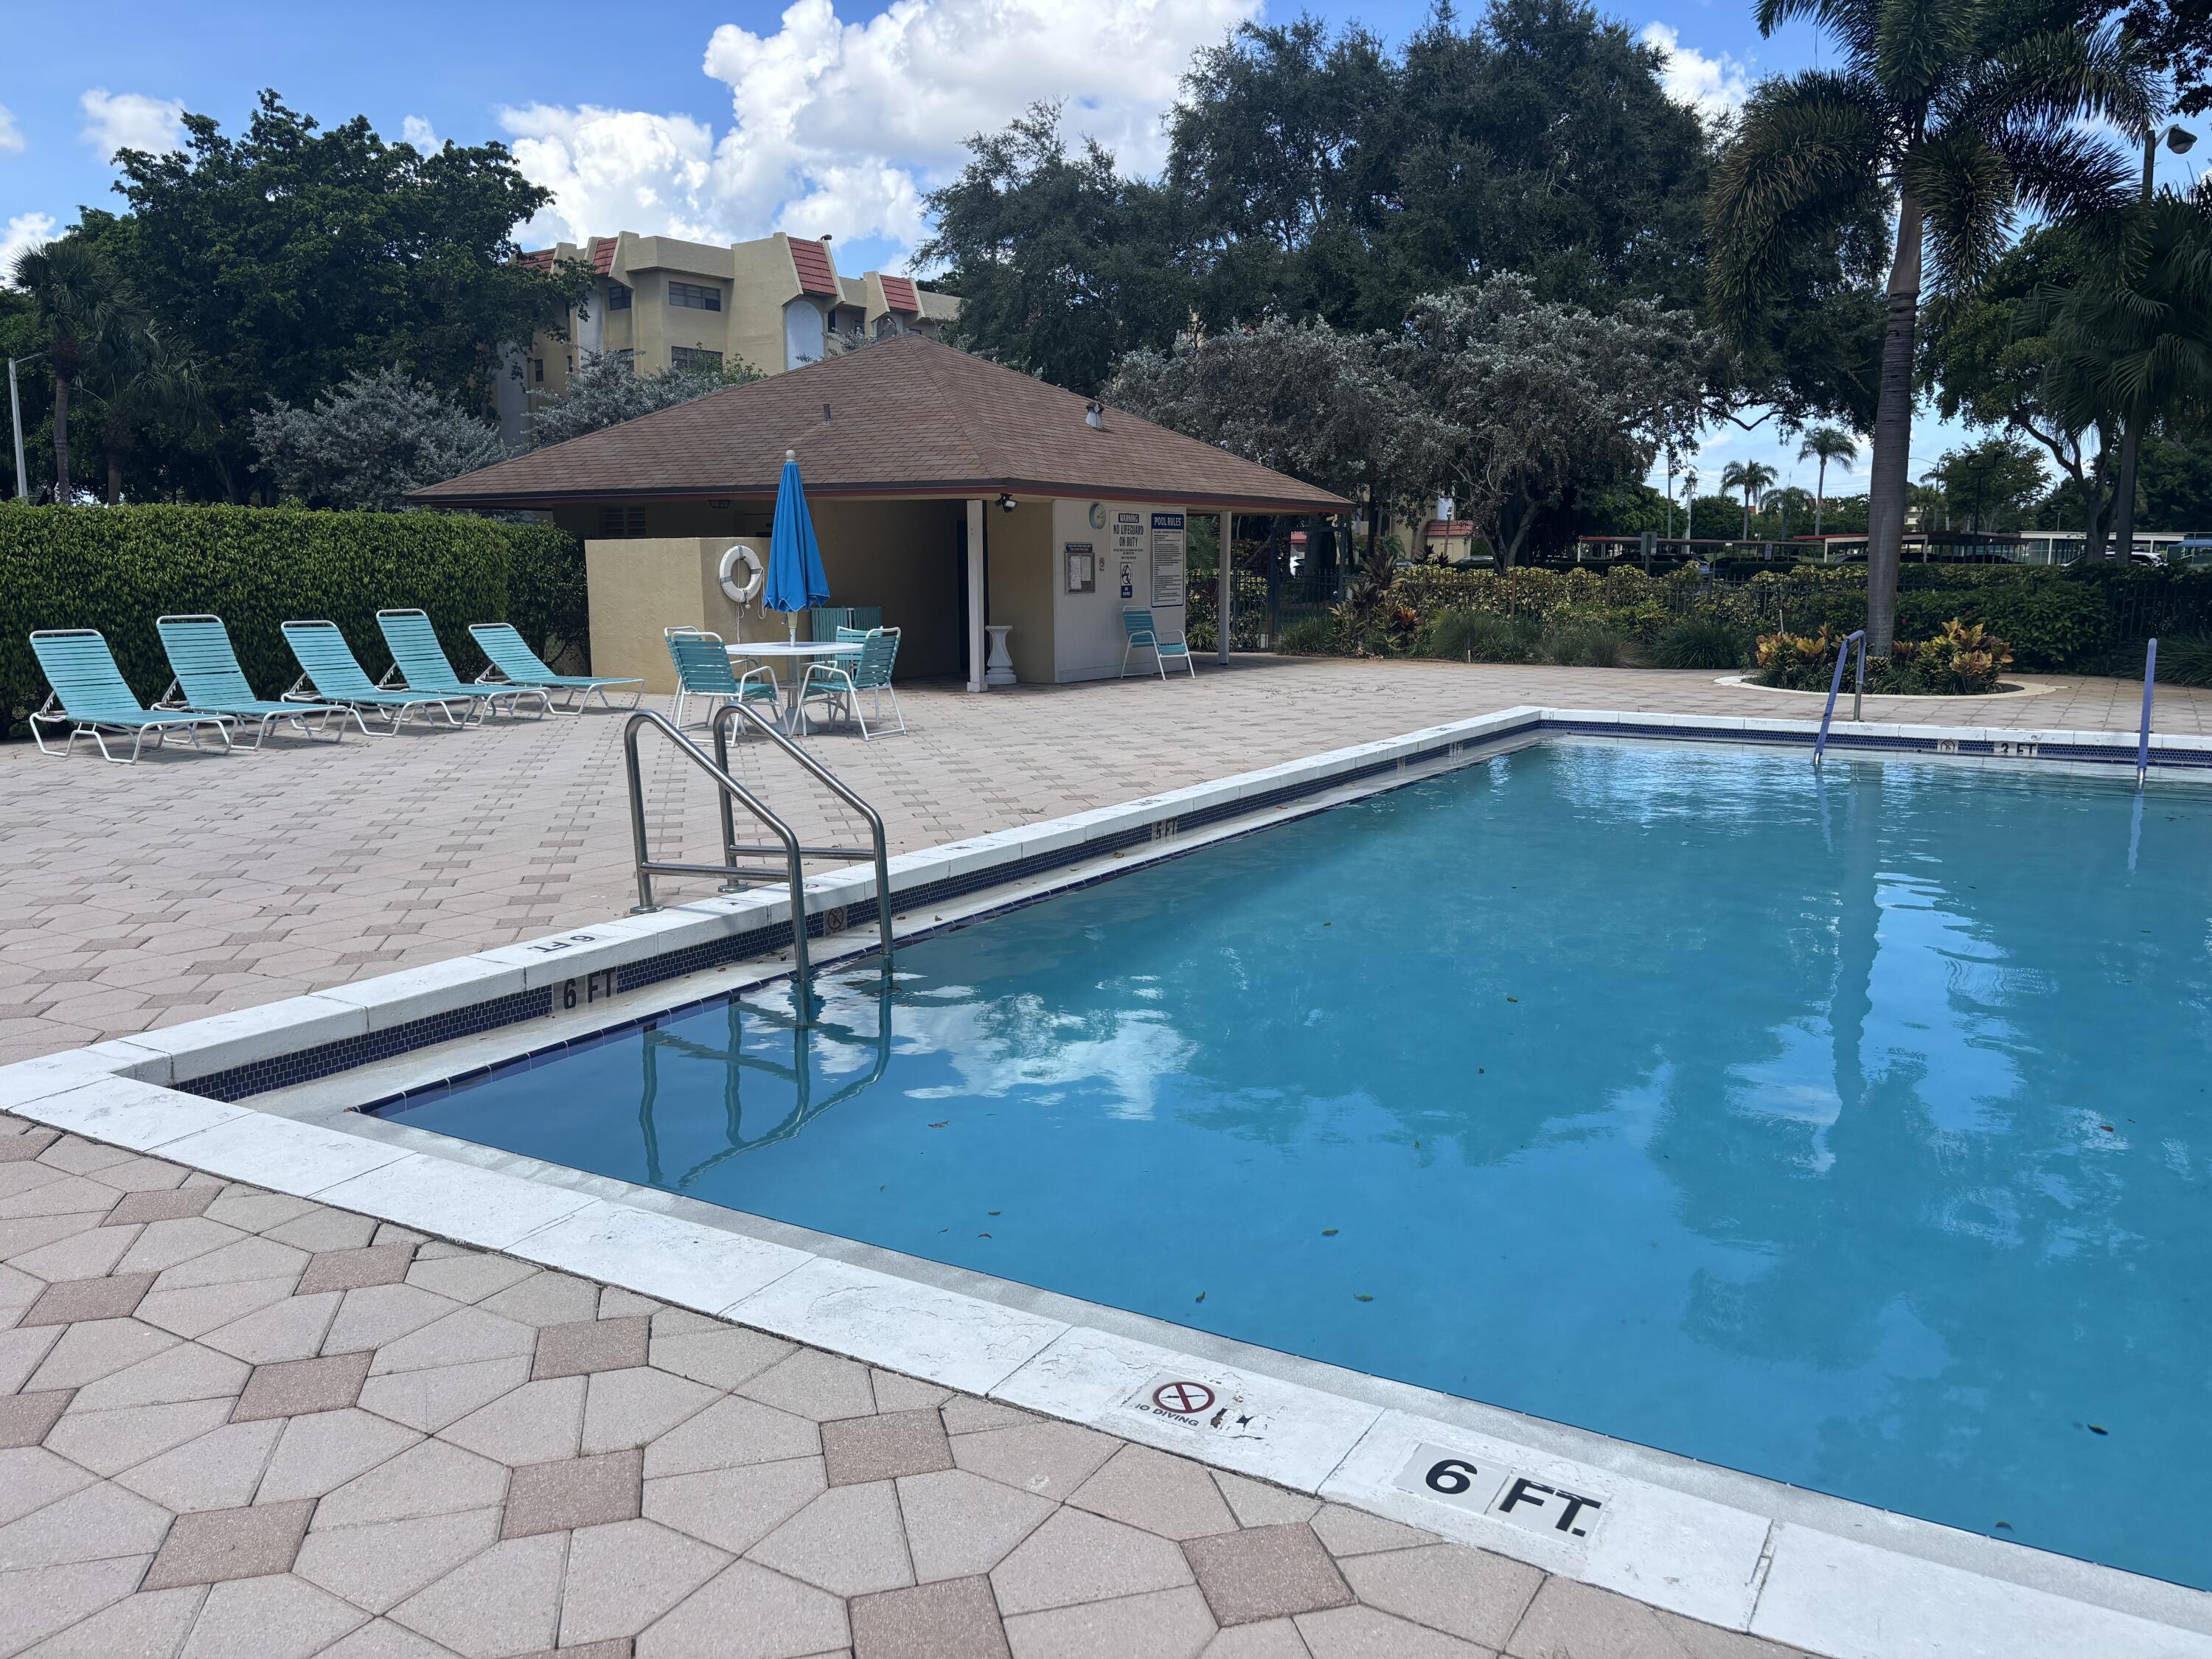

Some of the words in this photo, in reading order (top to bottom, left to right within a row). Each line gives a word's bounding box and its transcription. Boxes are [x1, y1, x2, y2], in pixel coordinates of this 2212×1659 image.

[1154, 516, 1166, 526] POOL
[1167, 517, 1181, 526] RULES
[1113, 525, 1120, 535] NO
[1121, 525, 1144, 535] LIFEGUARD
[1119, 537, 1125, 546] ON
[1127, 537, 1138, 547] DUTY
[2017, 742, 2037, 754] FT
[1155, 821, 1162, 840] 5
[1164, 817, 1178, 838] FT
[563, 978, 577, 1009] 6
[588, 966, 616, 1004] FT
[1152, 1408, 1200, 1427] DIVING
[1425, 1458, 1478, 1495] 6
[1498, 1477, 1602, 1537] FT.
